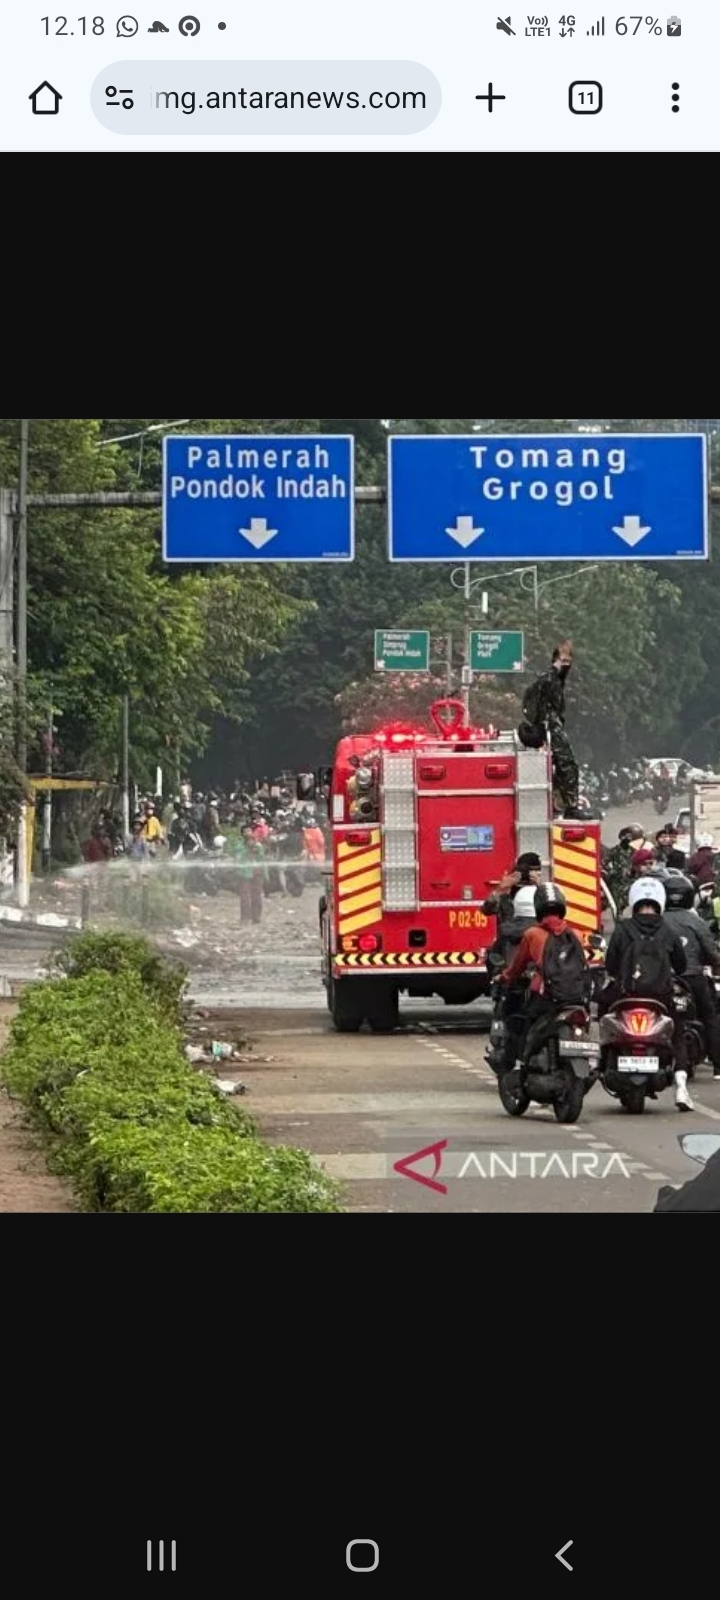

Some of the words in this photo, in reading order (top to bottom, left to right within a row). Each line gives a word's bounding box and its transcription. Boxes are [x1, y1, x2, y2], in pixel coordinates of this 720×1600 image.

[40, 15, 105, 36] 12.18
[557, 14, 576, 27] 4G
[614, 15, 663, 36] 67%
[524, 26, 551, 37] LTE1
[577, 91, 594, 105] 11
[187, 444, 329, 469] Palmerah
[469, 445, 626, 474] Tomang
[170, 474, 266, 499] Pondok
[276, 474, 346, 499] Indah
[482, 475, 614, 507] Grogol
[382, 633, 411, 641] Palmerah
[477, 633, 502, 643] Tomang
[477, 642, 499, 651] Grogol
[449, 910, 457, 928] P
